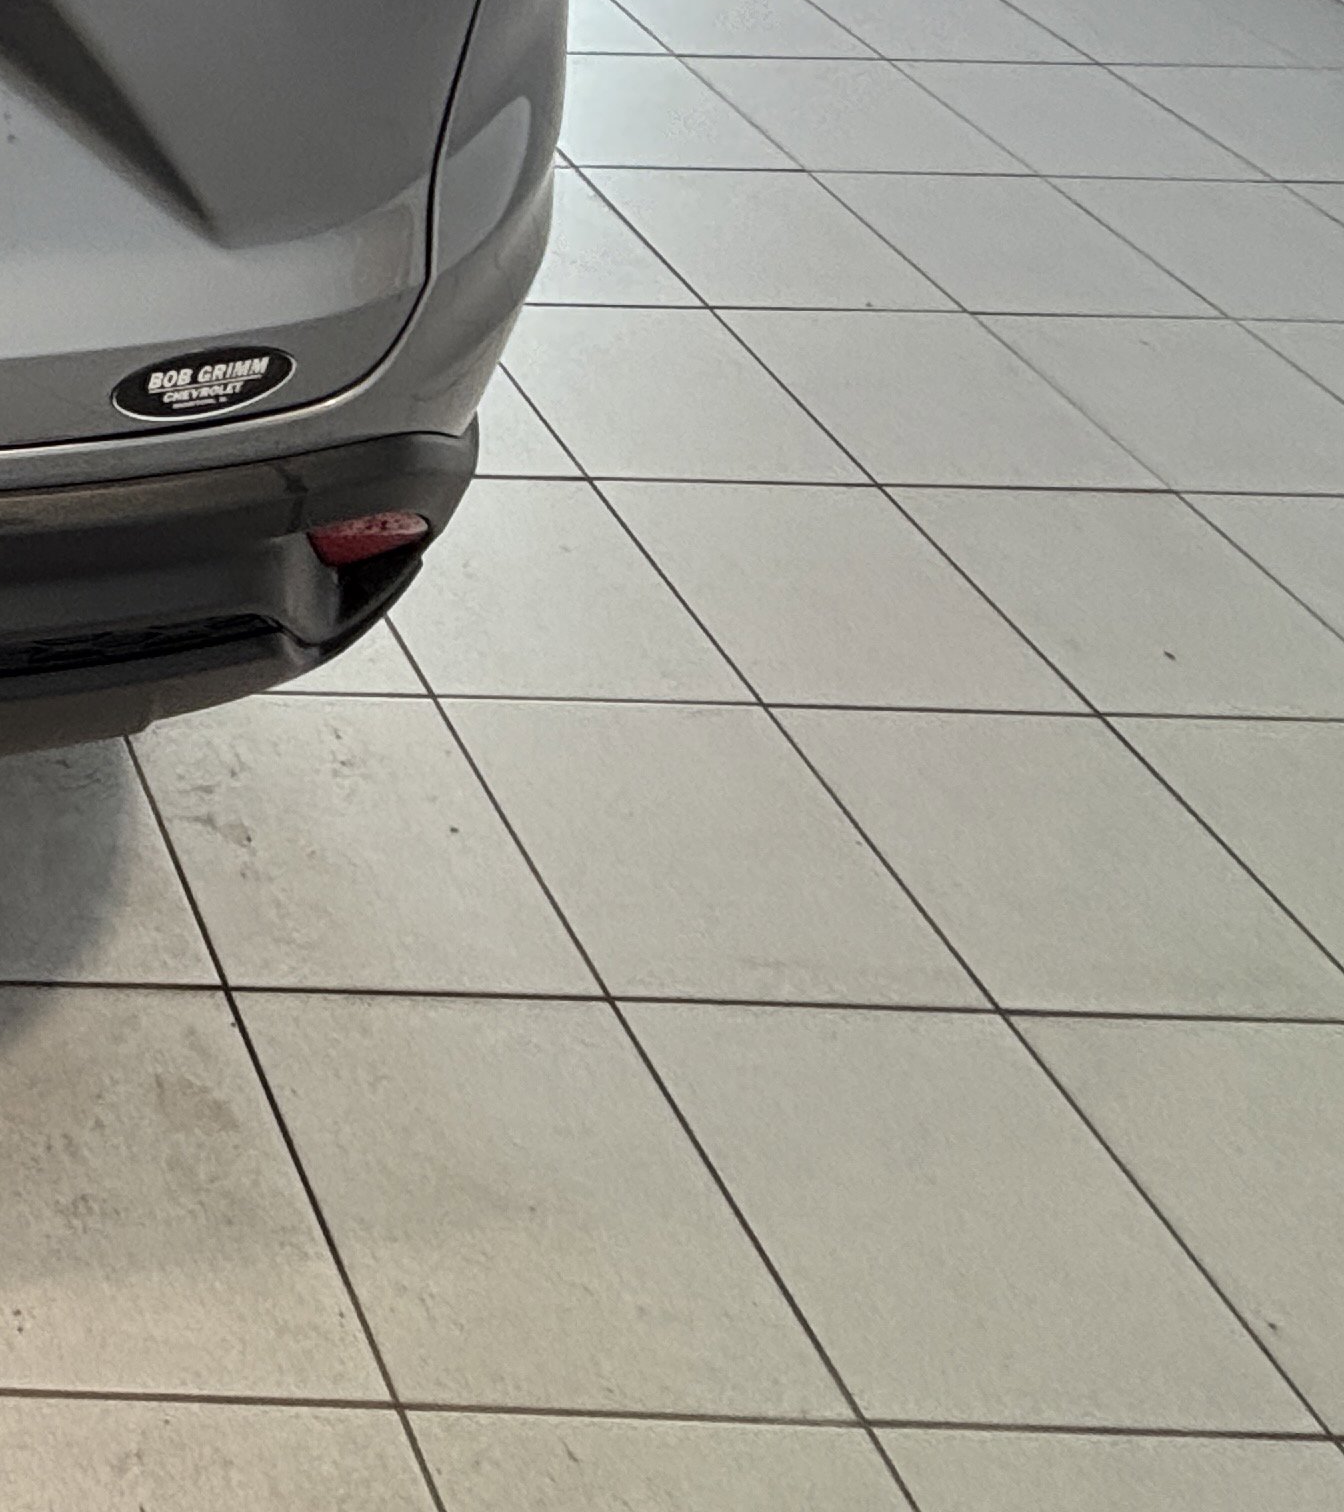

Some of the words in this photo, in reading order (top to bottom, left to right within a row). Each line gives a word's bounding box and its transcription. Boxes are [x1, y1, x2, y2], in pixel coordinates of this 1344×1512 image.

[148, 368, 193, 389] BOB
[197, 356, 270, 383] GRIMM
[163, 381, 244, 403] CHEVROLET
